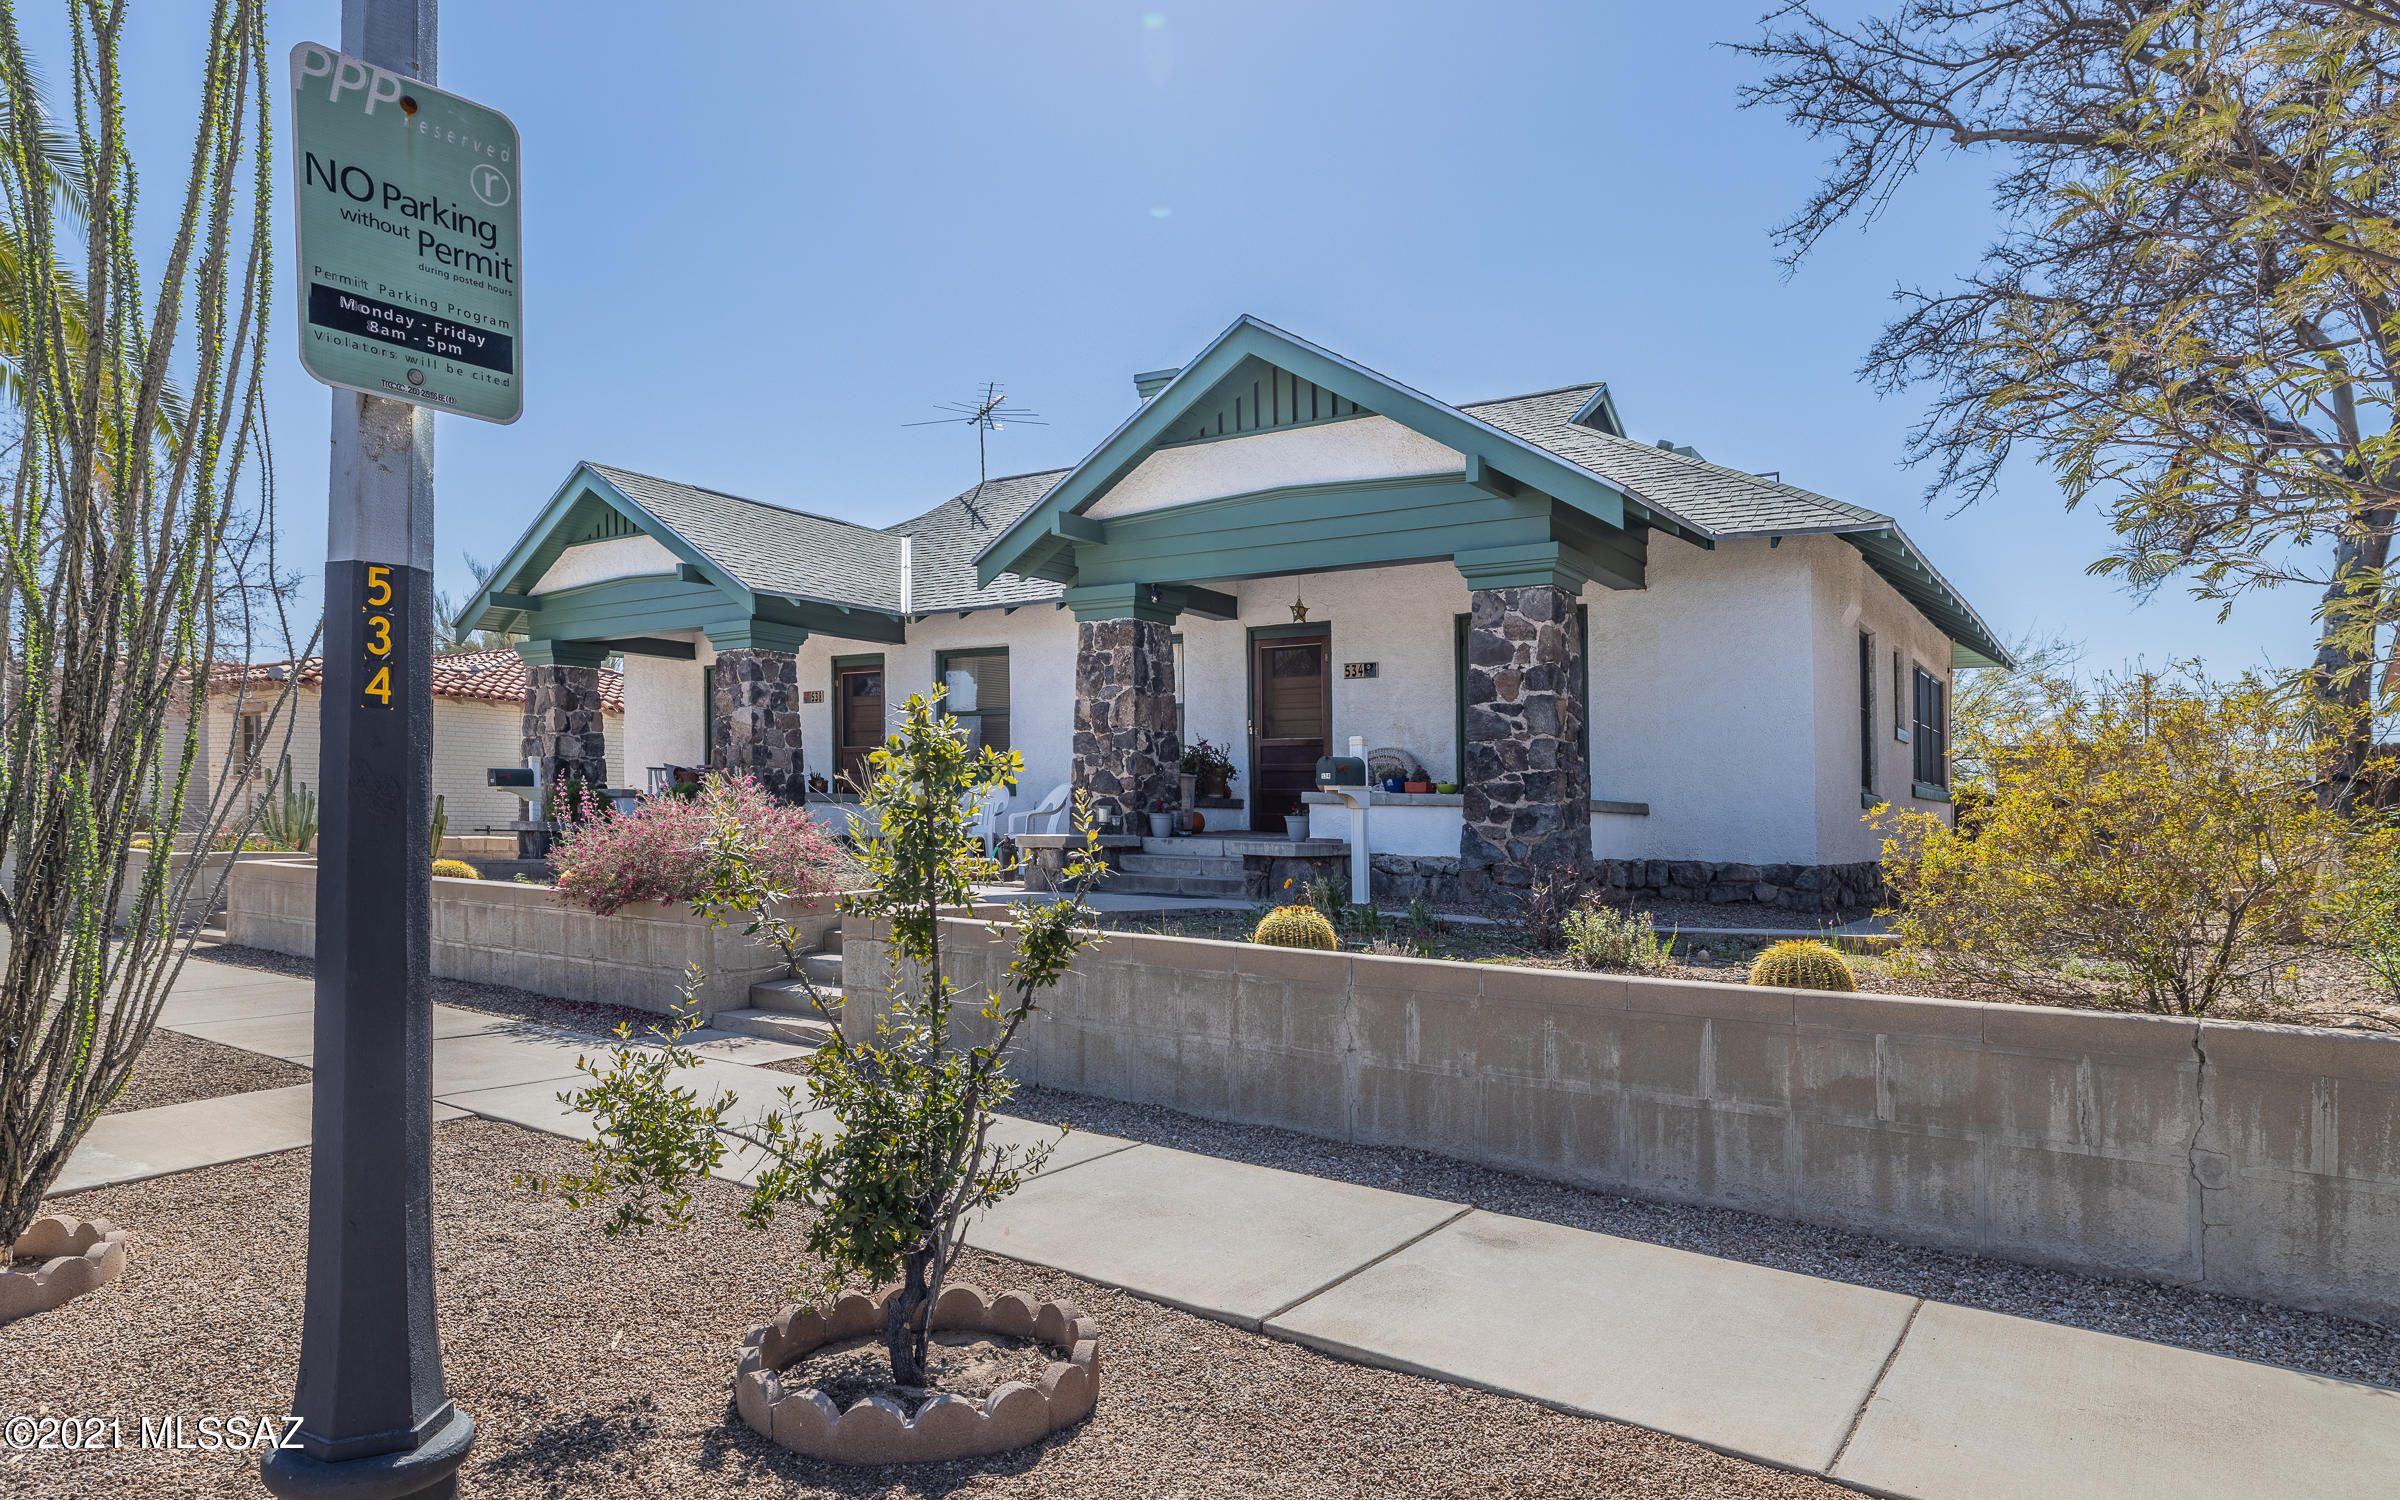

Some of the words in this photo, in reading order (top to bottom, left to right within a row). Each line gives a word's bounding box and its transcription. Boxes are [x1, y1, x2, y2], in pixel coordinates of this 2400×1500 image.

[296, 46, 401, 115] PPP
[306, 151, 375, 202] NO
[383, 181, 497, 249] Parking
[340, 207, 410, 239] without
[418, 229, 513, 283] Permit
[314, 265, 369, 291] Permit
[379, 283, 438, 312] Parking
[448, 303, 510, 329] Program
[418, 263, 450, 280] during
[453, 273, 484, 289] posted
[487, 282, 513, 297] hours
[340, 295, 415, 329] Monday
[434, 322, 486, 347] Friday
[366, 320, 406, 341] 8am
[427, 336, 463, 356] 5pm
[314, 329, 397, 360] Violators
[405, 354, 437, 370] will
[446, 363, 464, 377] be
[472, 371, 510, 388] cited
[365, 566, 392, 705] 534
[1345, 664, 1363, 677] 534
